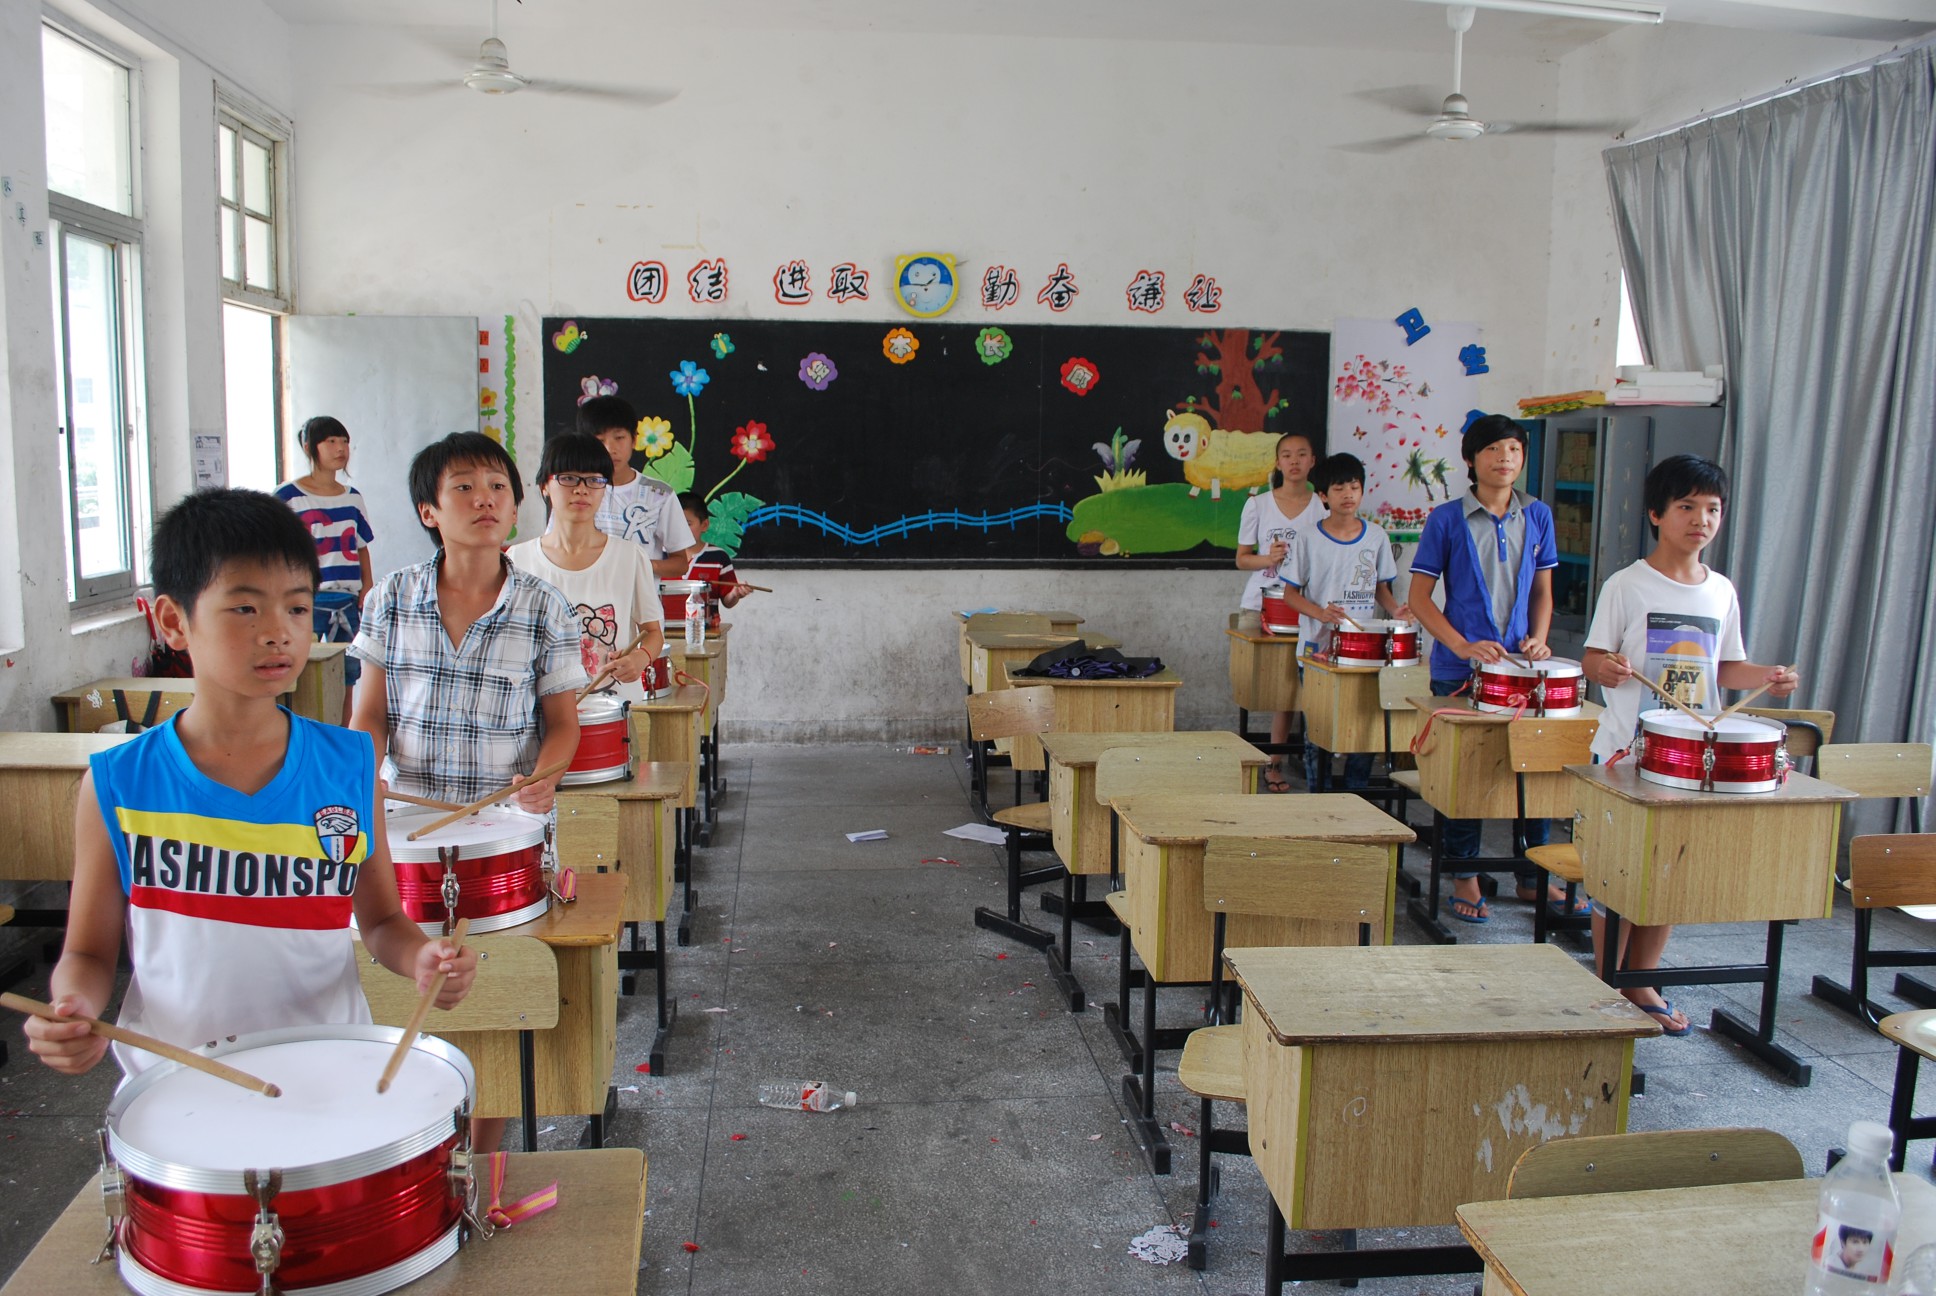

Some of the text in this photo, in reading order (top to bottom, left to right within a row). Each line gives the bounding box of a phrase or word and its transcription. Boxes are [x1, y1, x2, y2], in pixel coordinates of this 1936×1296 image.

[1666, 670, 1700, 683] DAY
[1663, 682, 1678, 692] OF
[319, 806, 354, 817] EAGLES
[123, 832, 358, 896] ASHIONSPO
